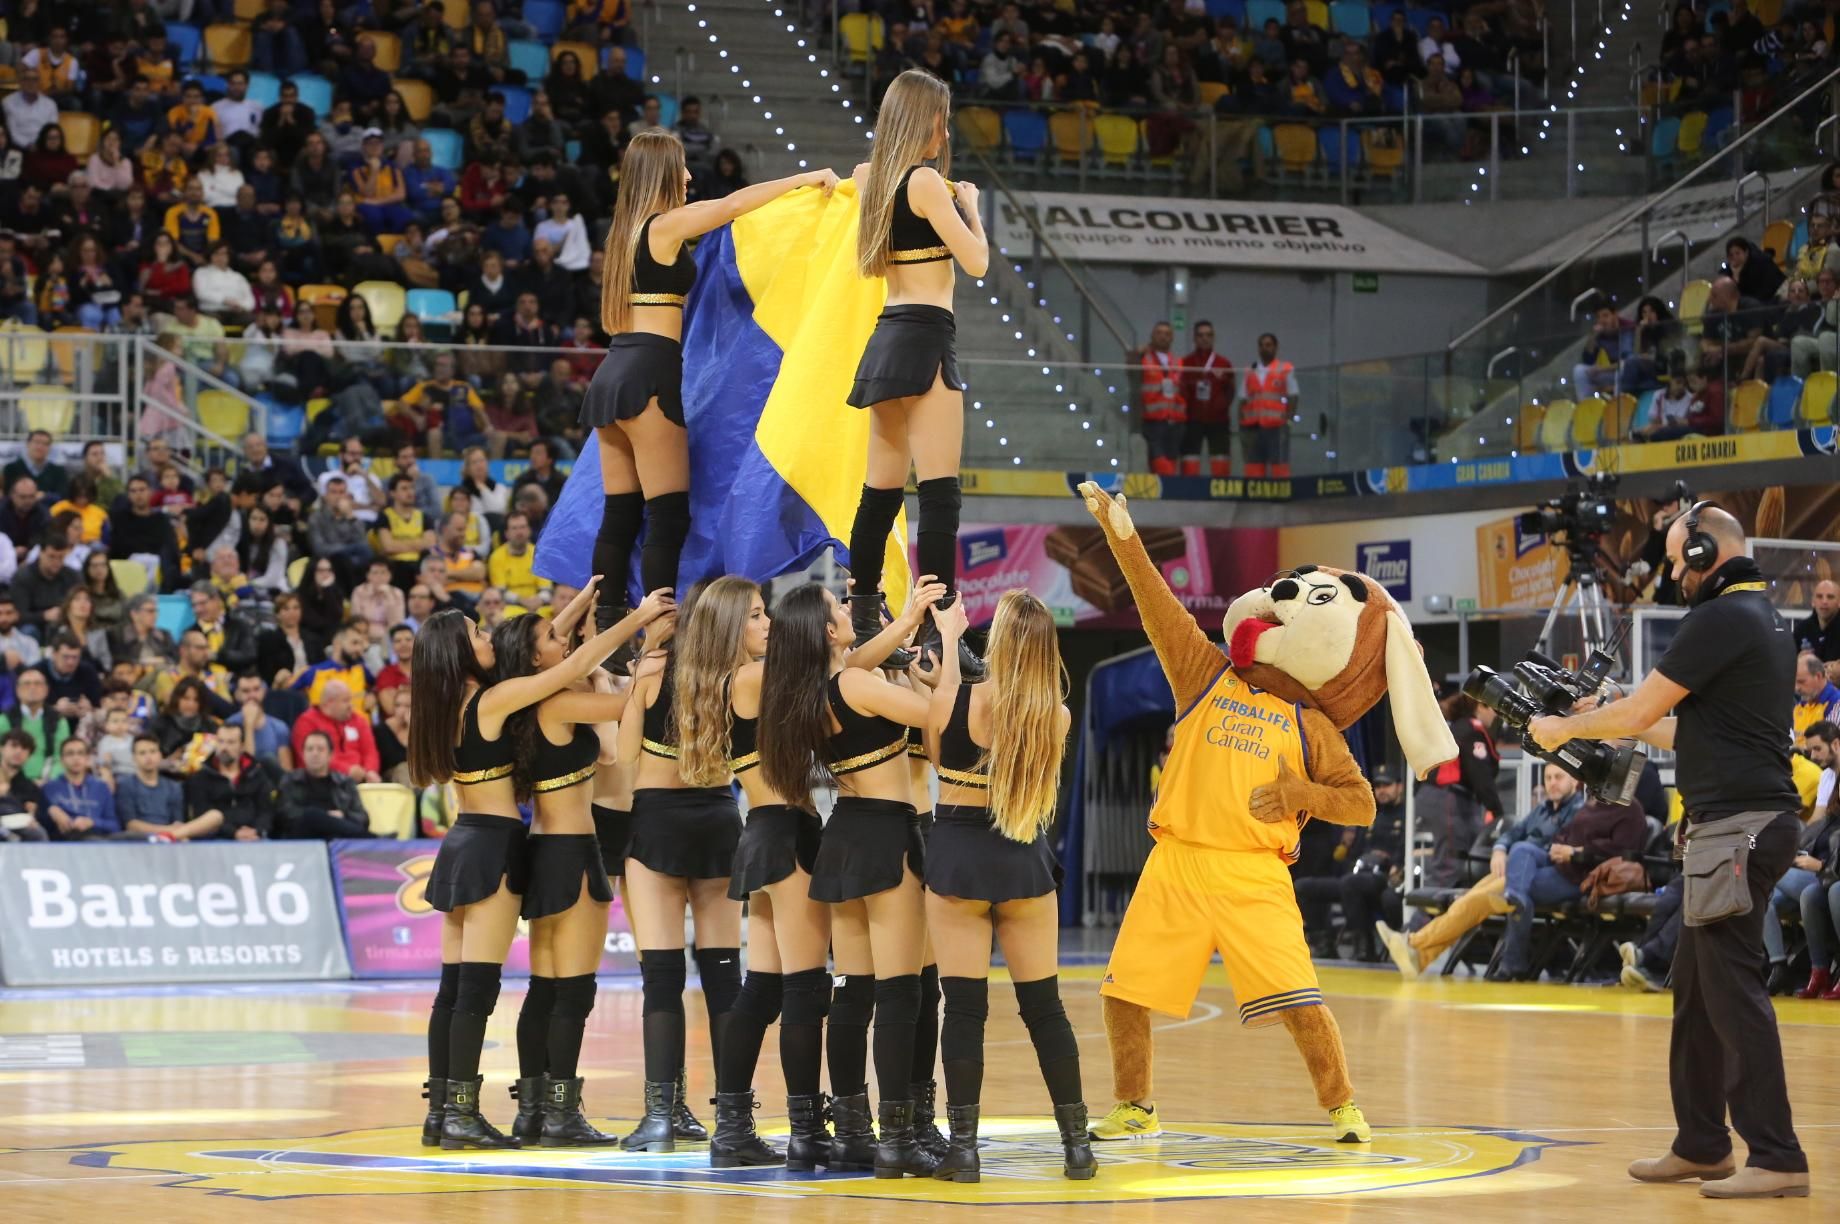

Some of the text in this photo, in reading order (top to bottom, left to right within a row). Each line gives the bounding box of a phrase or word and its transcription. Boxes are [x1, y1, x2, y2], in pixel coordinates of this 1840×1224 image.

[1001, 204, 1343, 238] HALCOURIER
[1048, 232, 1133, 246] equipo
[1146, 235, 1176, 246] un
[1183, 236, 1265, 249] mismo
[1273, 238, 1367, 254] objetivo
[1675, 440, 1737, 464] GRAN CANARIA
[1210, 478, 1243, 497] GRAN
[1363, 545, 1408, 579] Tirma
[1212, 695, 1291, 733] HERBALIFE
[1222, 715, 1264, 738] Gran
[1206, 726, 1270, 760] Canaria
[21, 863, 309, 928] Barceló
[53, 944, 302, 968] HOTELS & RESORTS
